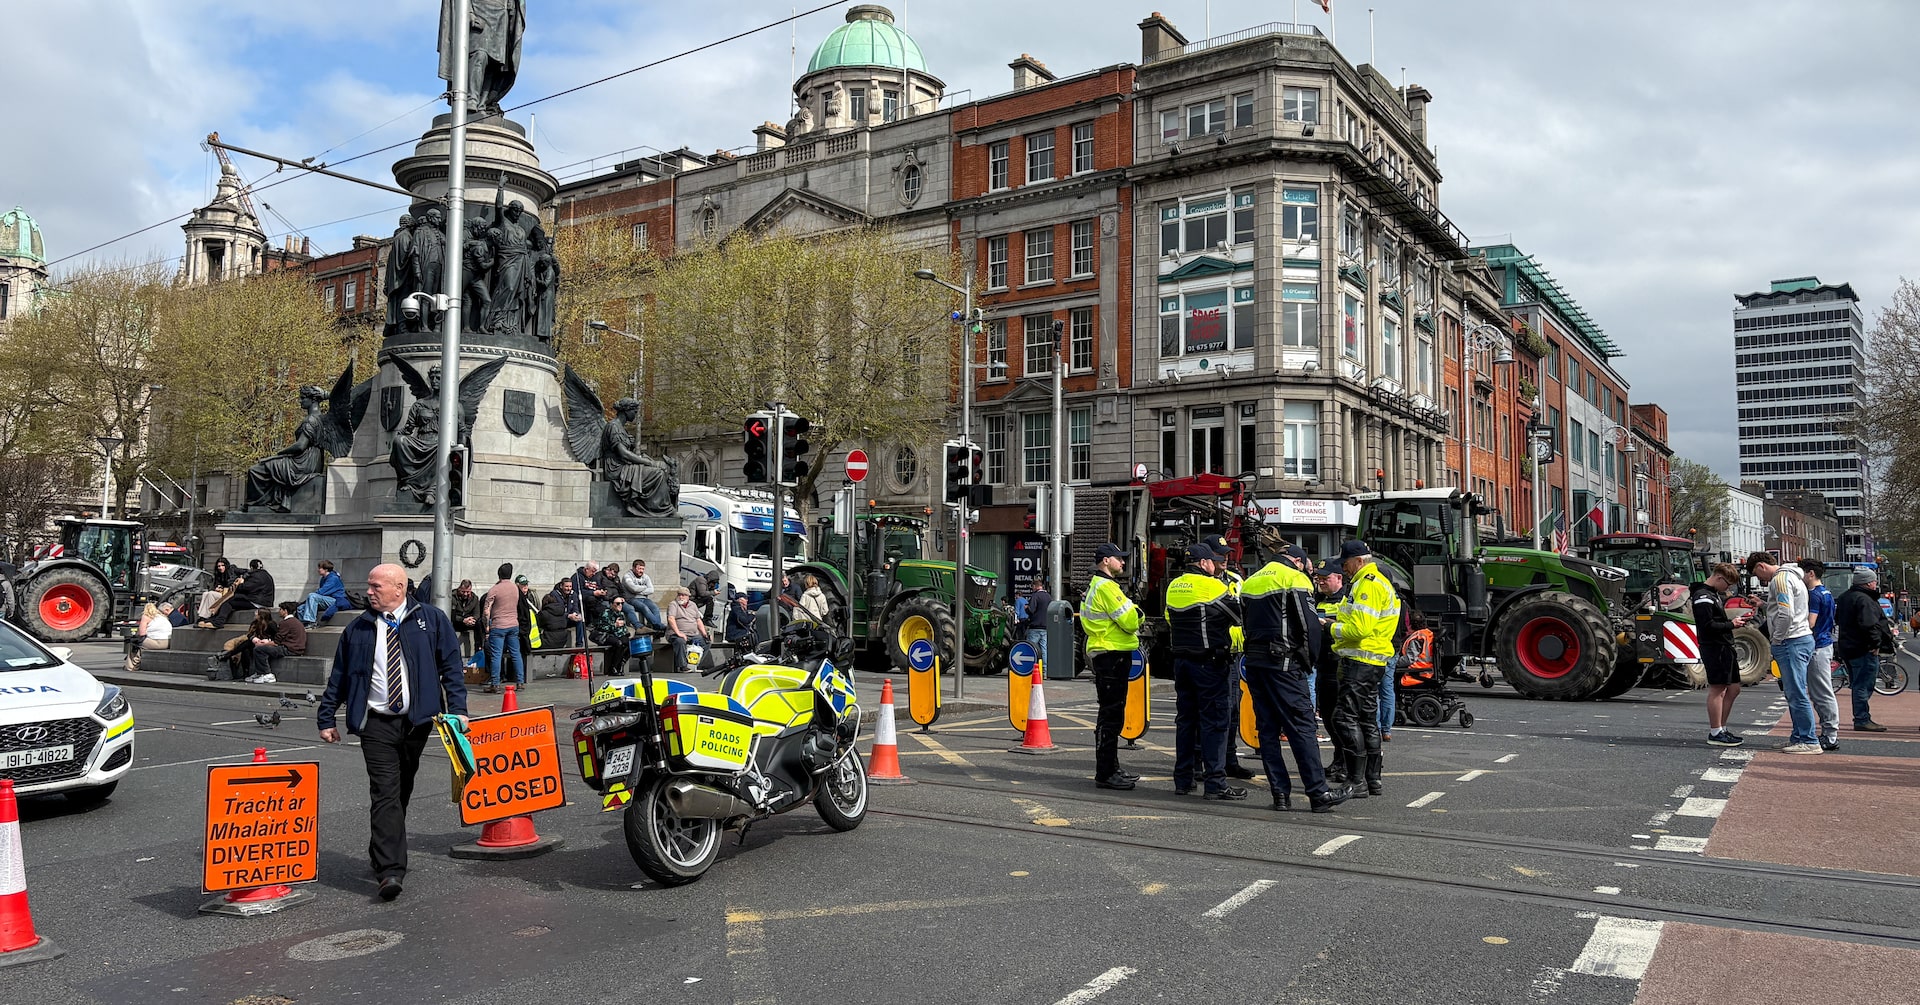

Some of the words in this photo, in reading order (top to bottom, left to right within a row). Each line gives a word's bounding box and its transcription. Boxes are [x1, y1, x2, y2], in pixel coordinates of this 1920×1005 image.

[1192, 308, 1220, 323] SPACE
[1209, 341, 1224, 349] 9777
[1013, 557, 1033, 571] TO
[0, 685, 62, 696] RDA
[510, 722, 547, 739] Dunta
[709, 729, 741, 745] ROADS
[701, 740, 744, 758] POLICING
[6, 748, 69, 768] 191-D-41822
[475, 747, 541, 777] ROAD
[610, 762, 630, 775] 21238
[465, 775, 558, 810] CLOSED
[288, 797, 306, 811] ar
[209, 819, 289, 841] Mhalairt
[292, 815, 316, 834] Slí
[212, 839, 310, 865] DIVERTED
[223, 863, 303, 886] TRAFFIC
